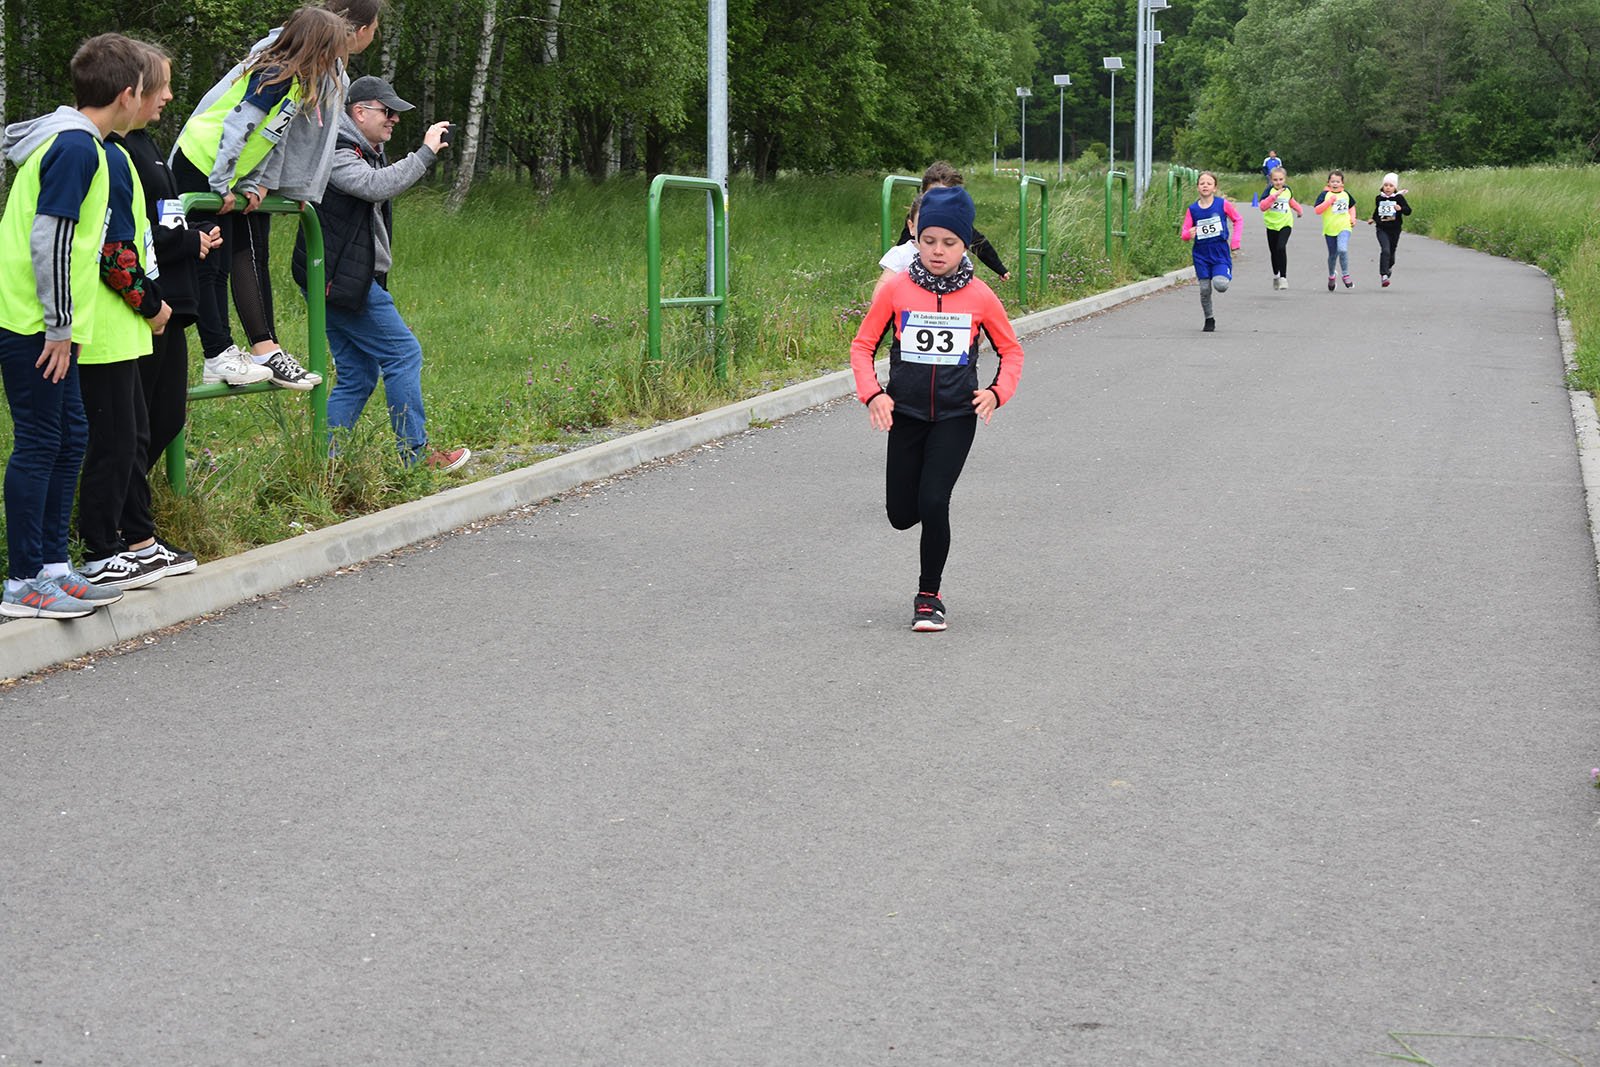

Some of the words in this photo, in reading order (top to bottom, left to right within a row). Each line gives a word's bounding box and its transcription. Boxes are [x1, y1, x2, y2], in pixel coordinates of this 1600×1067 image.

[275, 116, 291, 135] 2
[1273, 202, 1284, 210] 21
[1337, 203, 1347, 211] 22
[1202, 224, 1216, 234] 65
[916, 329, 954, 352] 93
